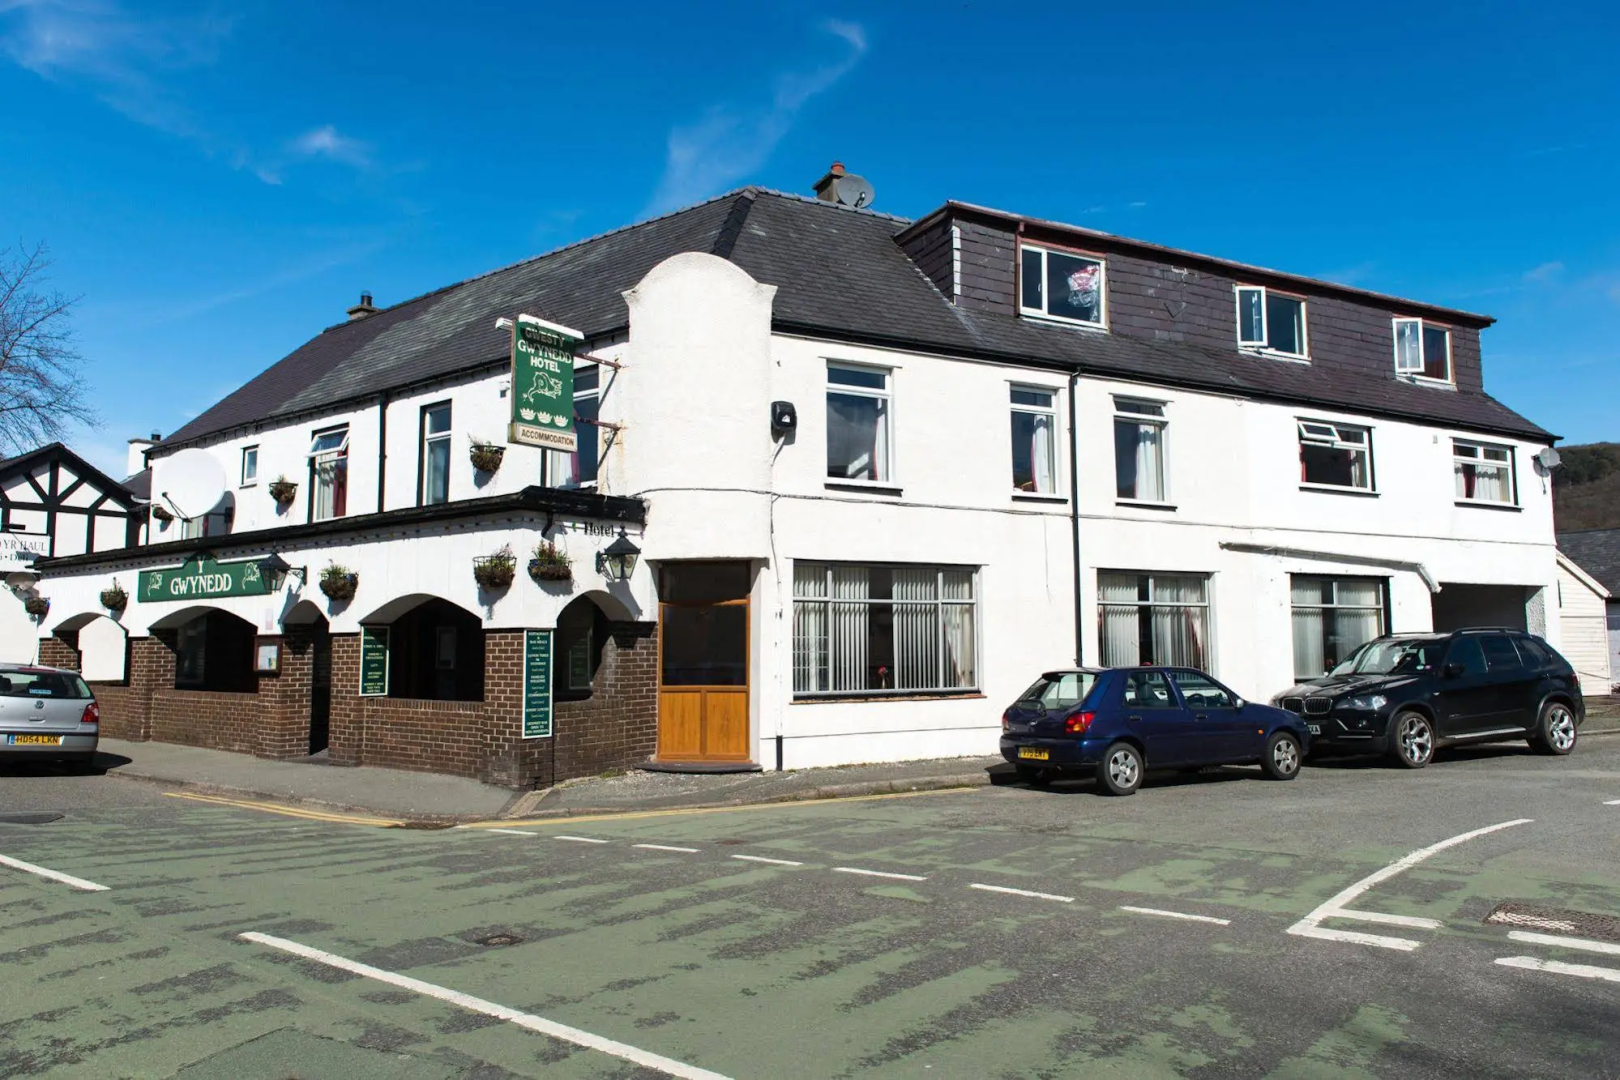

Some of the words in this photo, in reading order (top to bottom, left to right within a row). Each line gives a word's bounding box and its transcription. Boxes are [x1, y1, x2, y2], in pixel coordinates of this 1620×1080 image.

[524, 327, 566, 348] GWESTY
[517, 339, 572, 364] GWYNEDD
[530, 355, 561, 373] HOTEL
[521, 429, 575, 447] ACCOMMODATION
[583, 521, 614, 537] Hotel
[4, 539, 16, 550] YR
[20, 540, 46, 552] HAUL
[197, 555, 206, 573] Y
[170, 573, 232, 595] GWYNEDD
